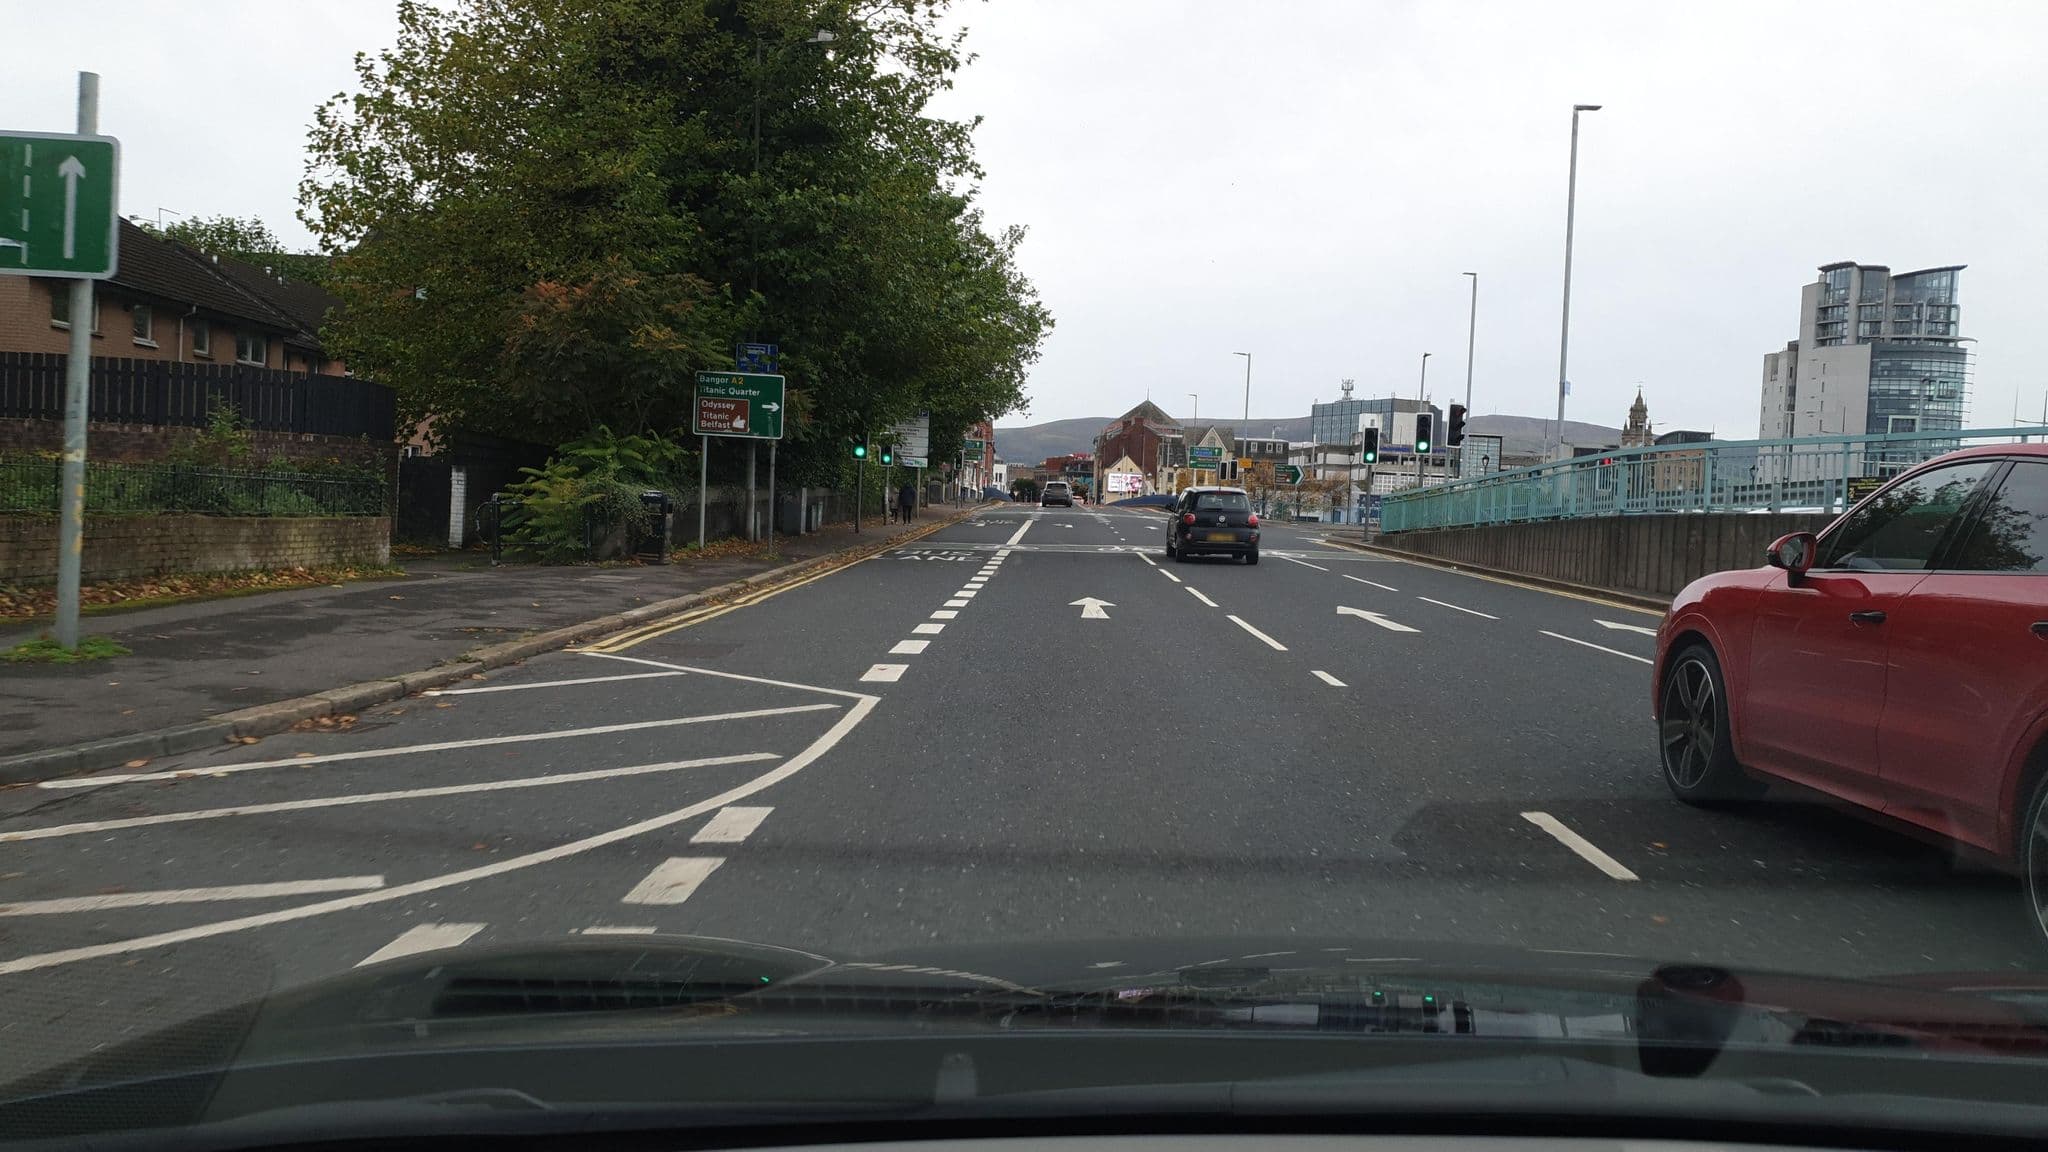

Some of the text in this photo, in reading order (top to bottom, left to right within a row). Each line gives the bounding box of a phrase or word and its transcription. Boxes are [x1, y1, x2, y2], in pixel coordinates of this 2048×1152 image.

[700, 375, 744, 385] Bangor A2
[728, 387, 760, 396] Quarter
[701, 400, 736, 411] Odyssey
[703, 411, 729, 420] Titanic
[701, 420, 731, 429] Belfast
